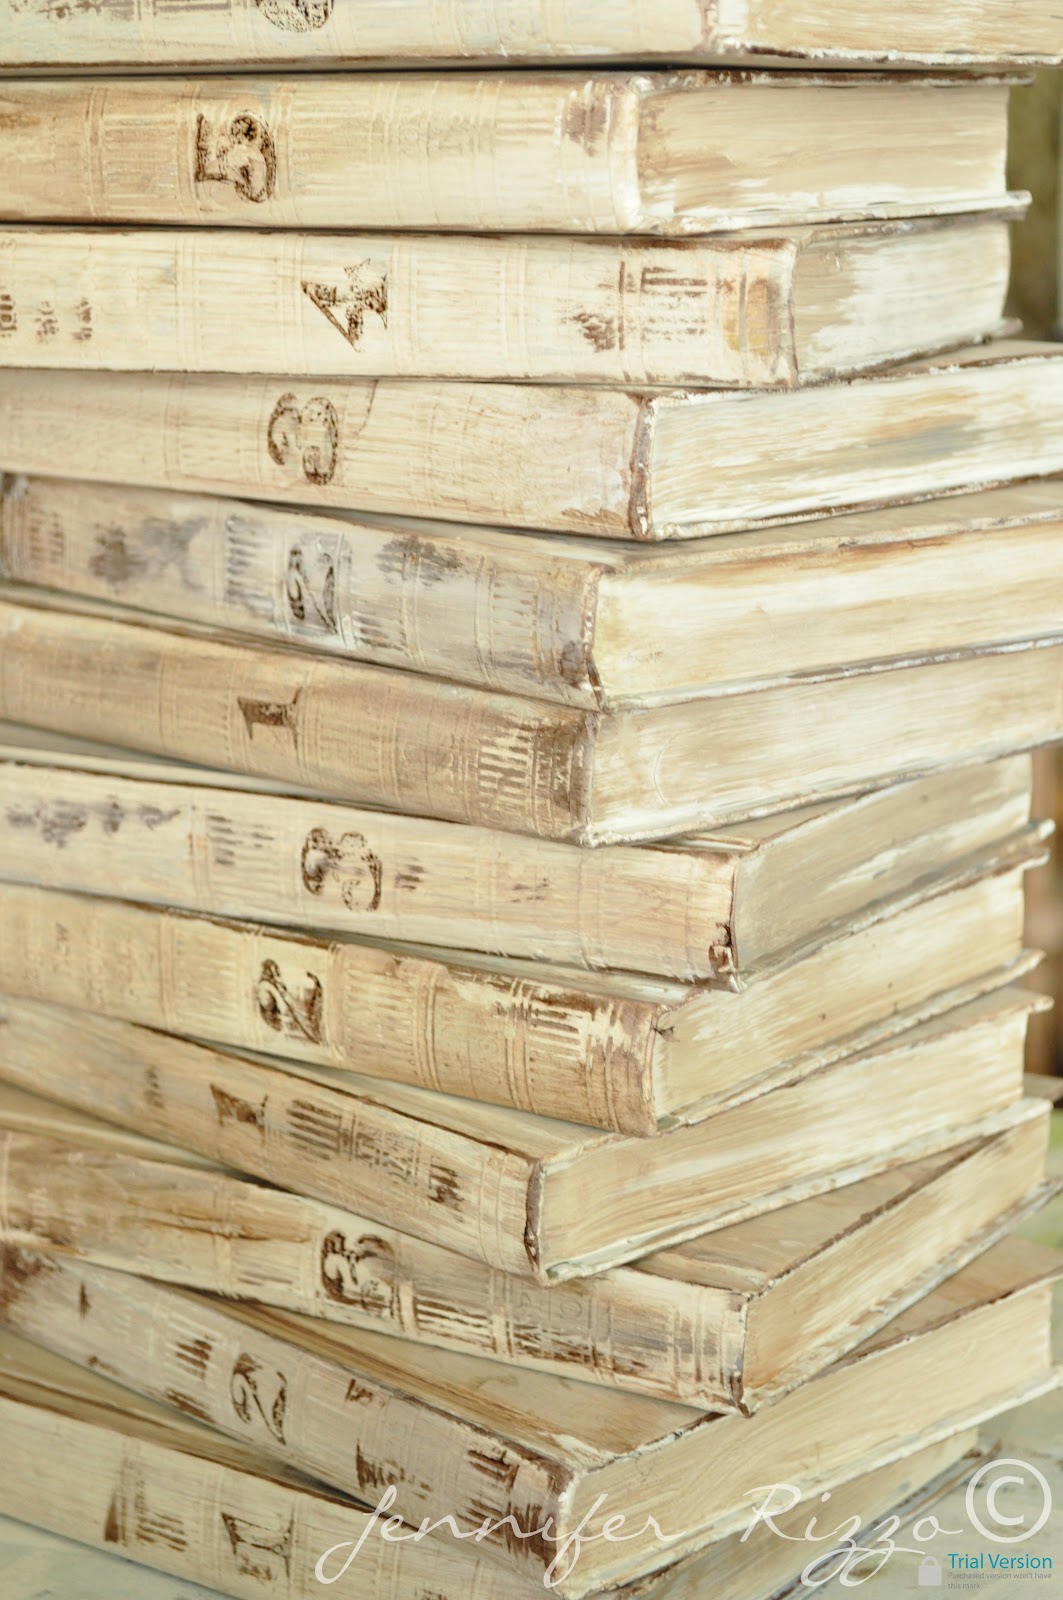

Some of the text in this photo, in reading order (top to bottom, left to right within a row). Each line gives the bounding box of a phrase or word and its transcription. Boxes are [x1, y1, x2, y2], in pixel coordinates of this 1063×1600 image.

[193, 109, 277, 203] 5
[300, 257, 388, 353] 4
[267, 392, 340, 486] 3
[286, 543, 338, 634] 2
[237, 686, 301, 756] 1
[300, 827, 384, 913] 3
[257, 958, 324, 1045] 2
[320, 1229, 401, 1317] 3
[229, 1352, 289, 1446] 2
